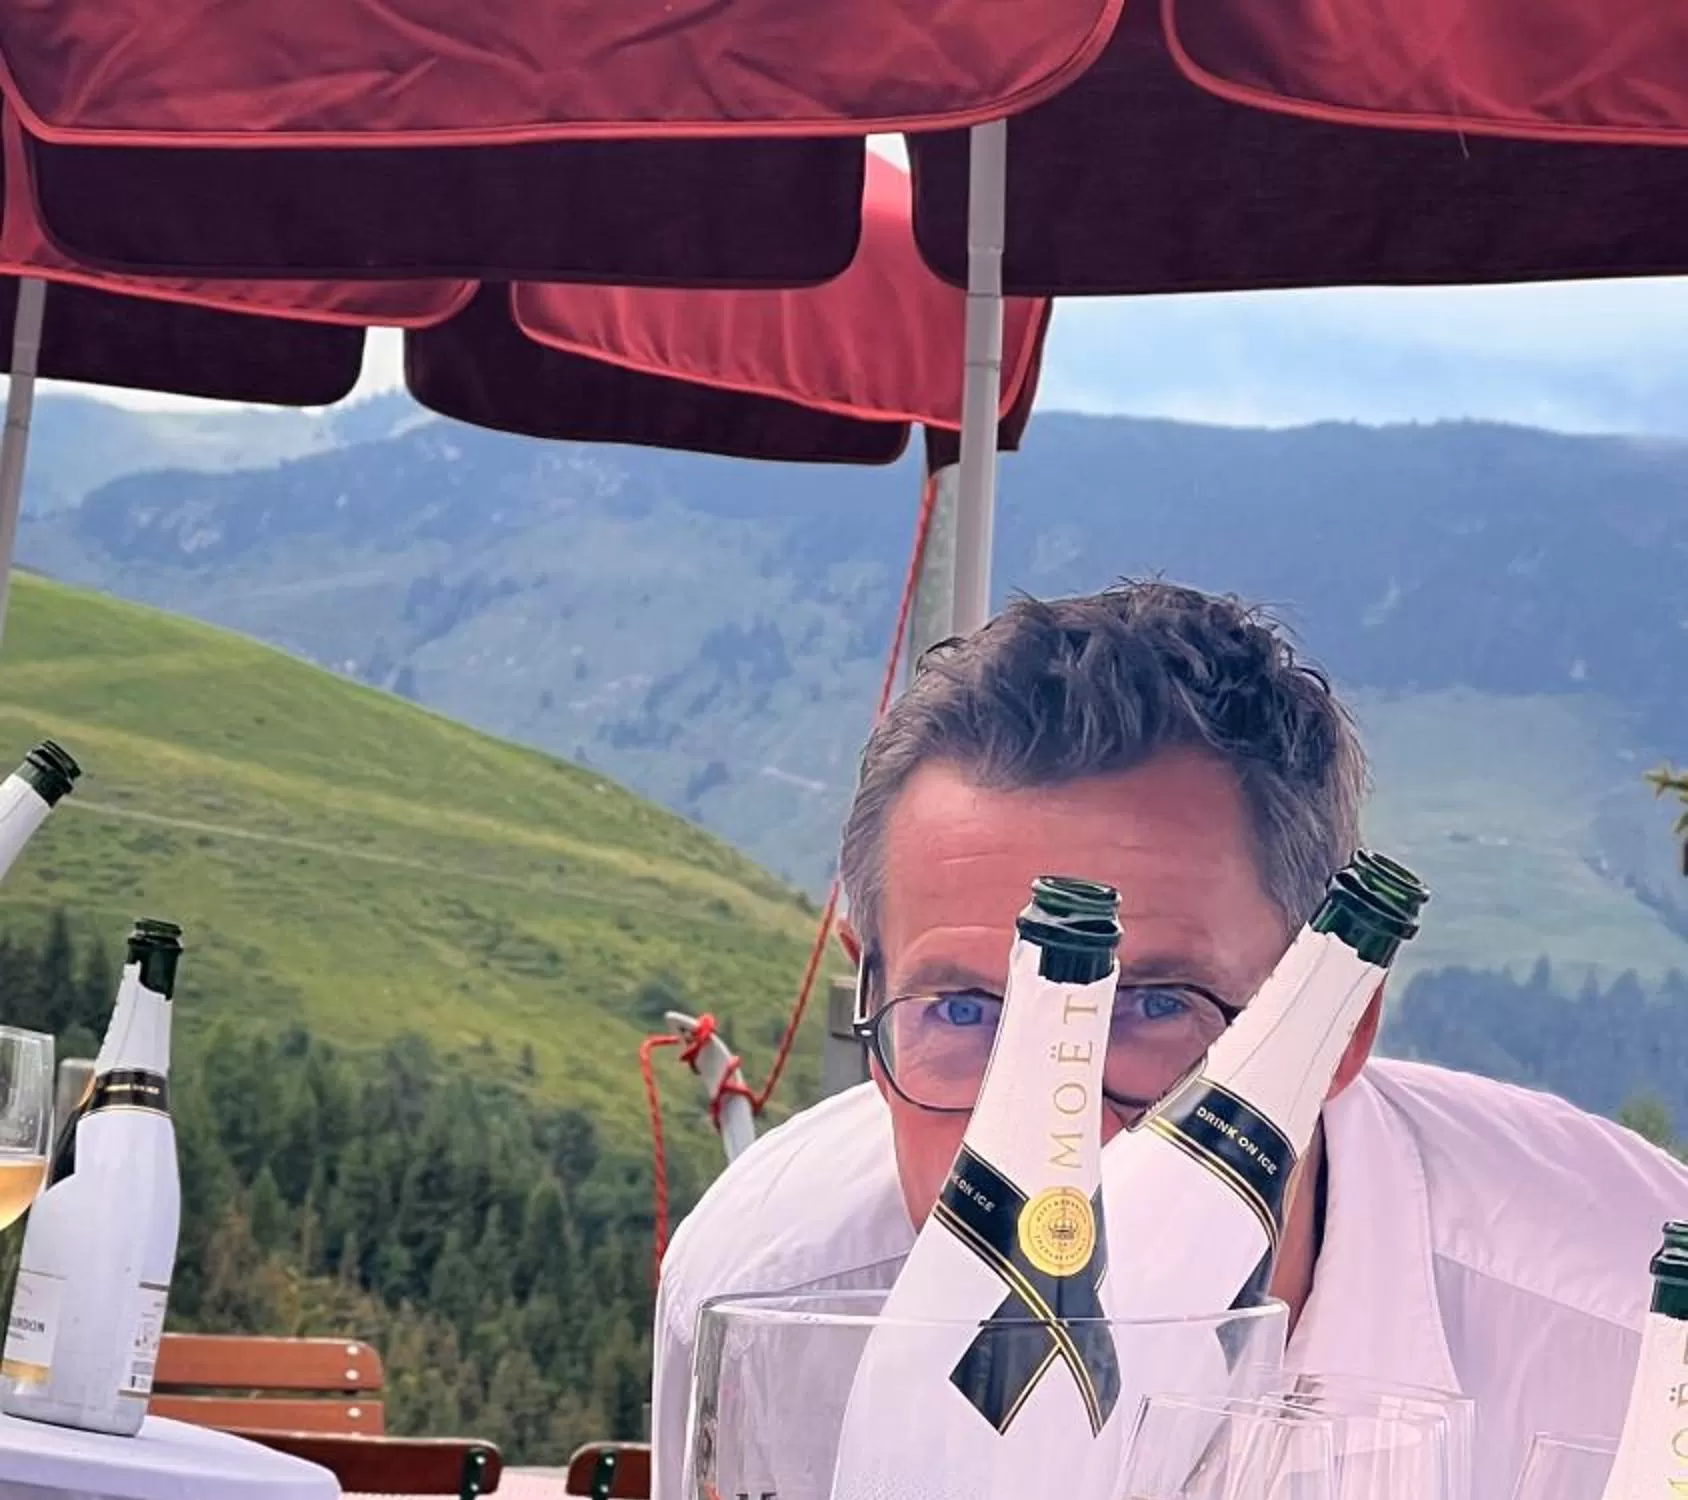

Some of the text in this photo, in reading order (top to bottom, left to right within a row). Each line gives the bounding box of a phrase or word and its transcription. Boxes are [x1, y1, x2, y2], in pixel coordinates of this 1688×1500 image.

[1049, 994, 1098, 1170] MOËT
[1196, 1106, 1277, 1175] DRINK ON ICE
[973, 1191, 996, 1213] ICE
